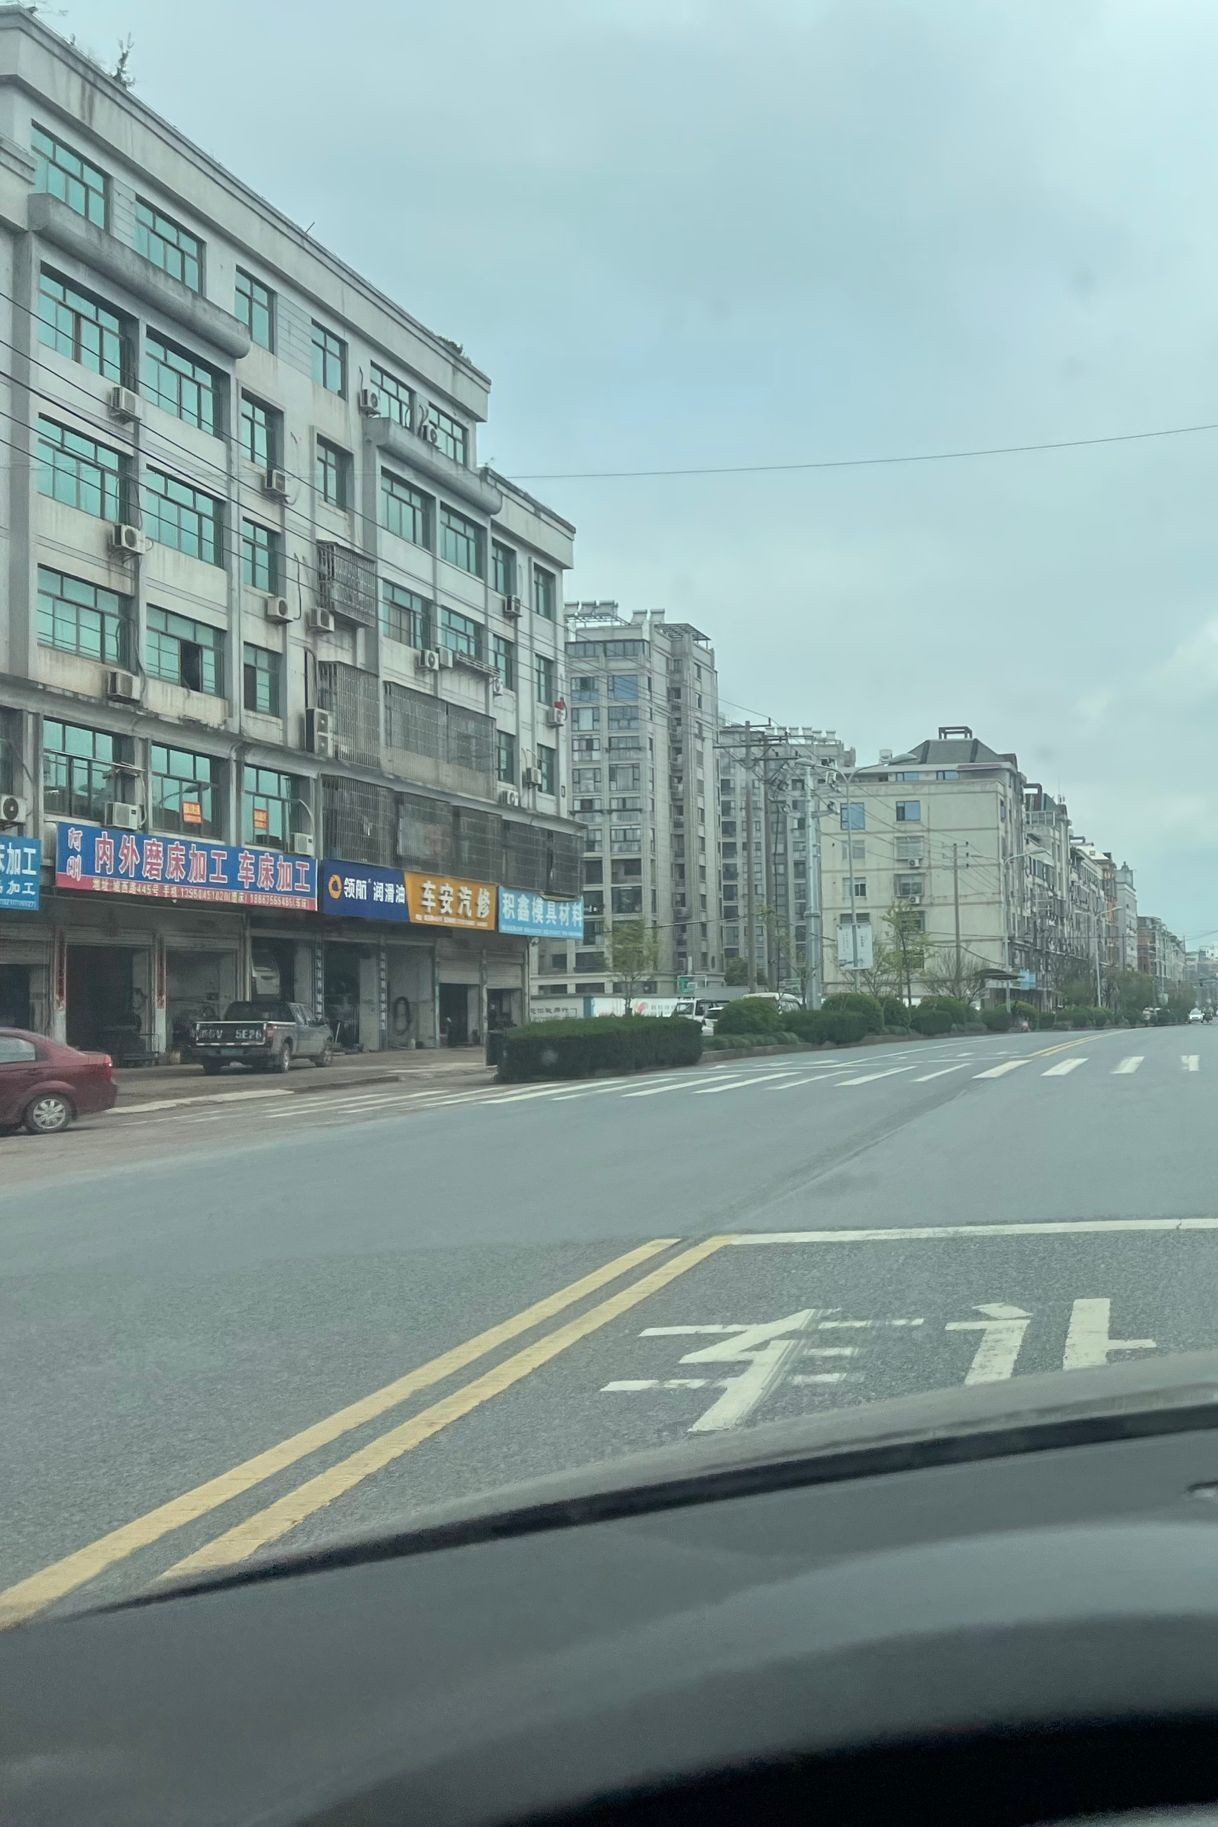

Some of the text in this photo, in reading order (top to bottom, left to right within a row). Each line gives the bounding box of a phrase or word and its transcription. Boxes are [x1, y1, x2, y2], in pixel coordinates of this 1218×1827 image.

[95, 831, 311, 892] 内外磨床加工 车床加工
[0, 880, 36, 895] 加工
[344, 877, 405, 904] 领航 润滑油
[421, 880, 490, 918] 车安汽修
